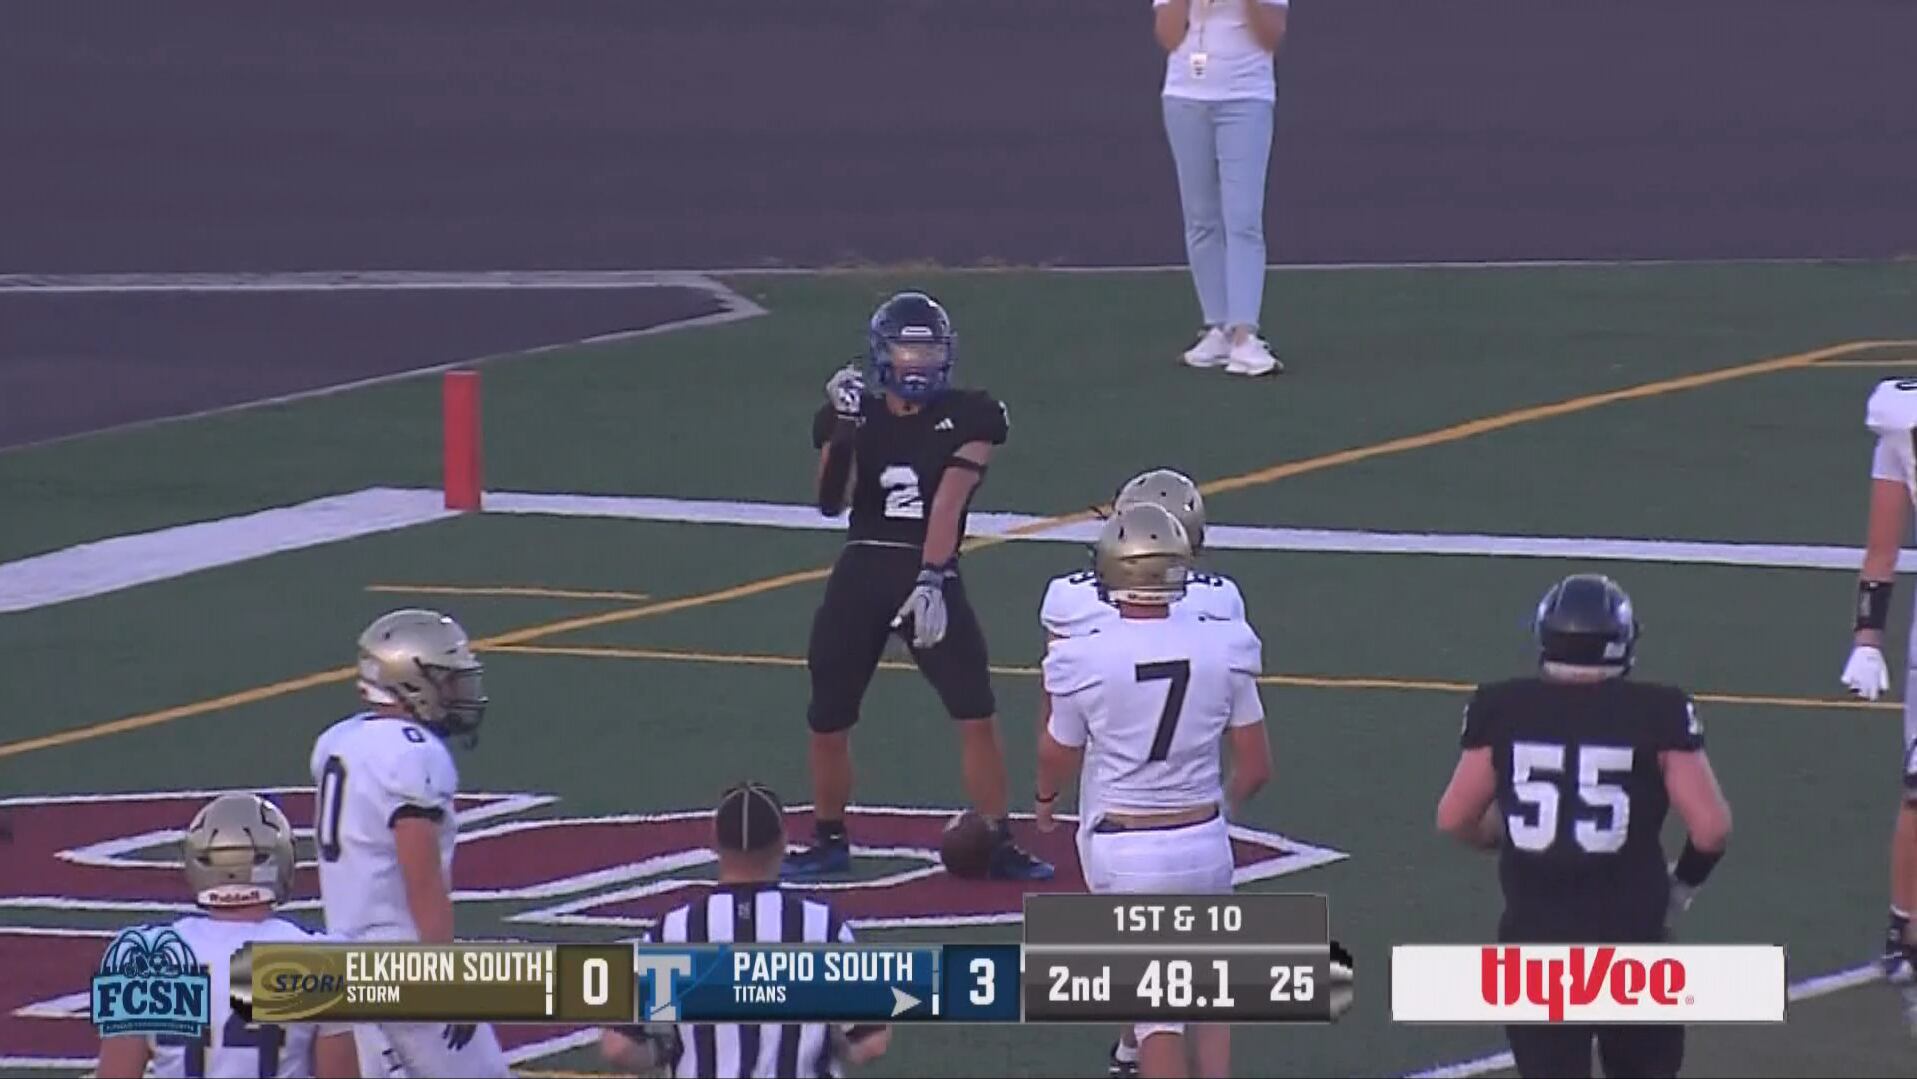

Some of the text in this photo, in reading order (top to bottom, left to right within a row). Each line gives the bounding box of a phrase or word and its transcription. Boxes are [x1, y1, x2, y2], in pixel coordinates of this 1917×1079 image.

[880, 465, 924, 519] 2
[1134, 658, 1191, 762] 7
[1508, 741, 1634, 853] 55
